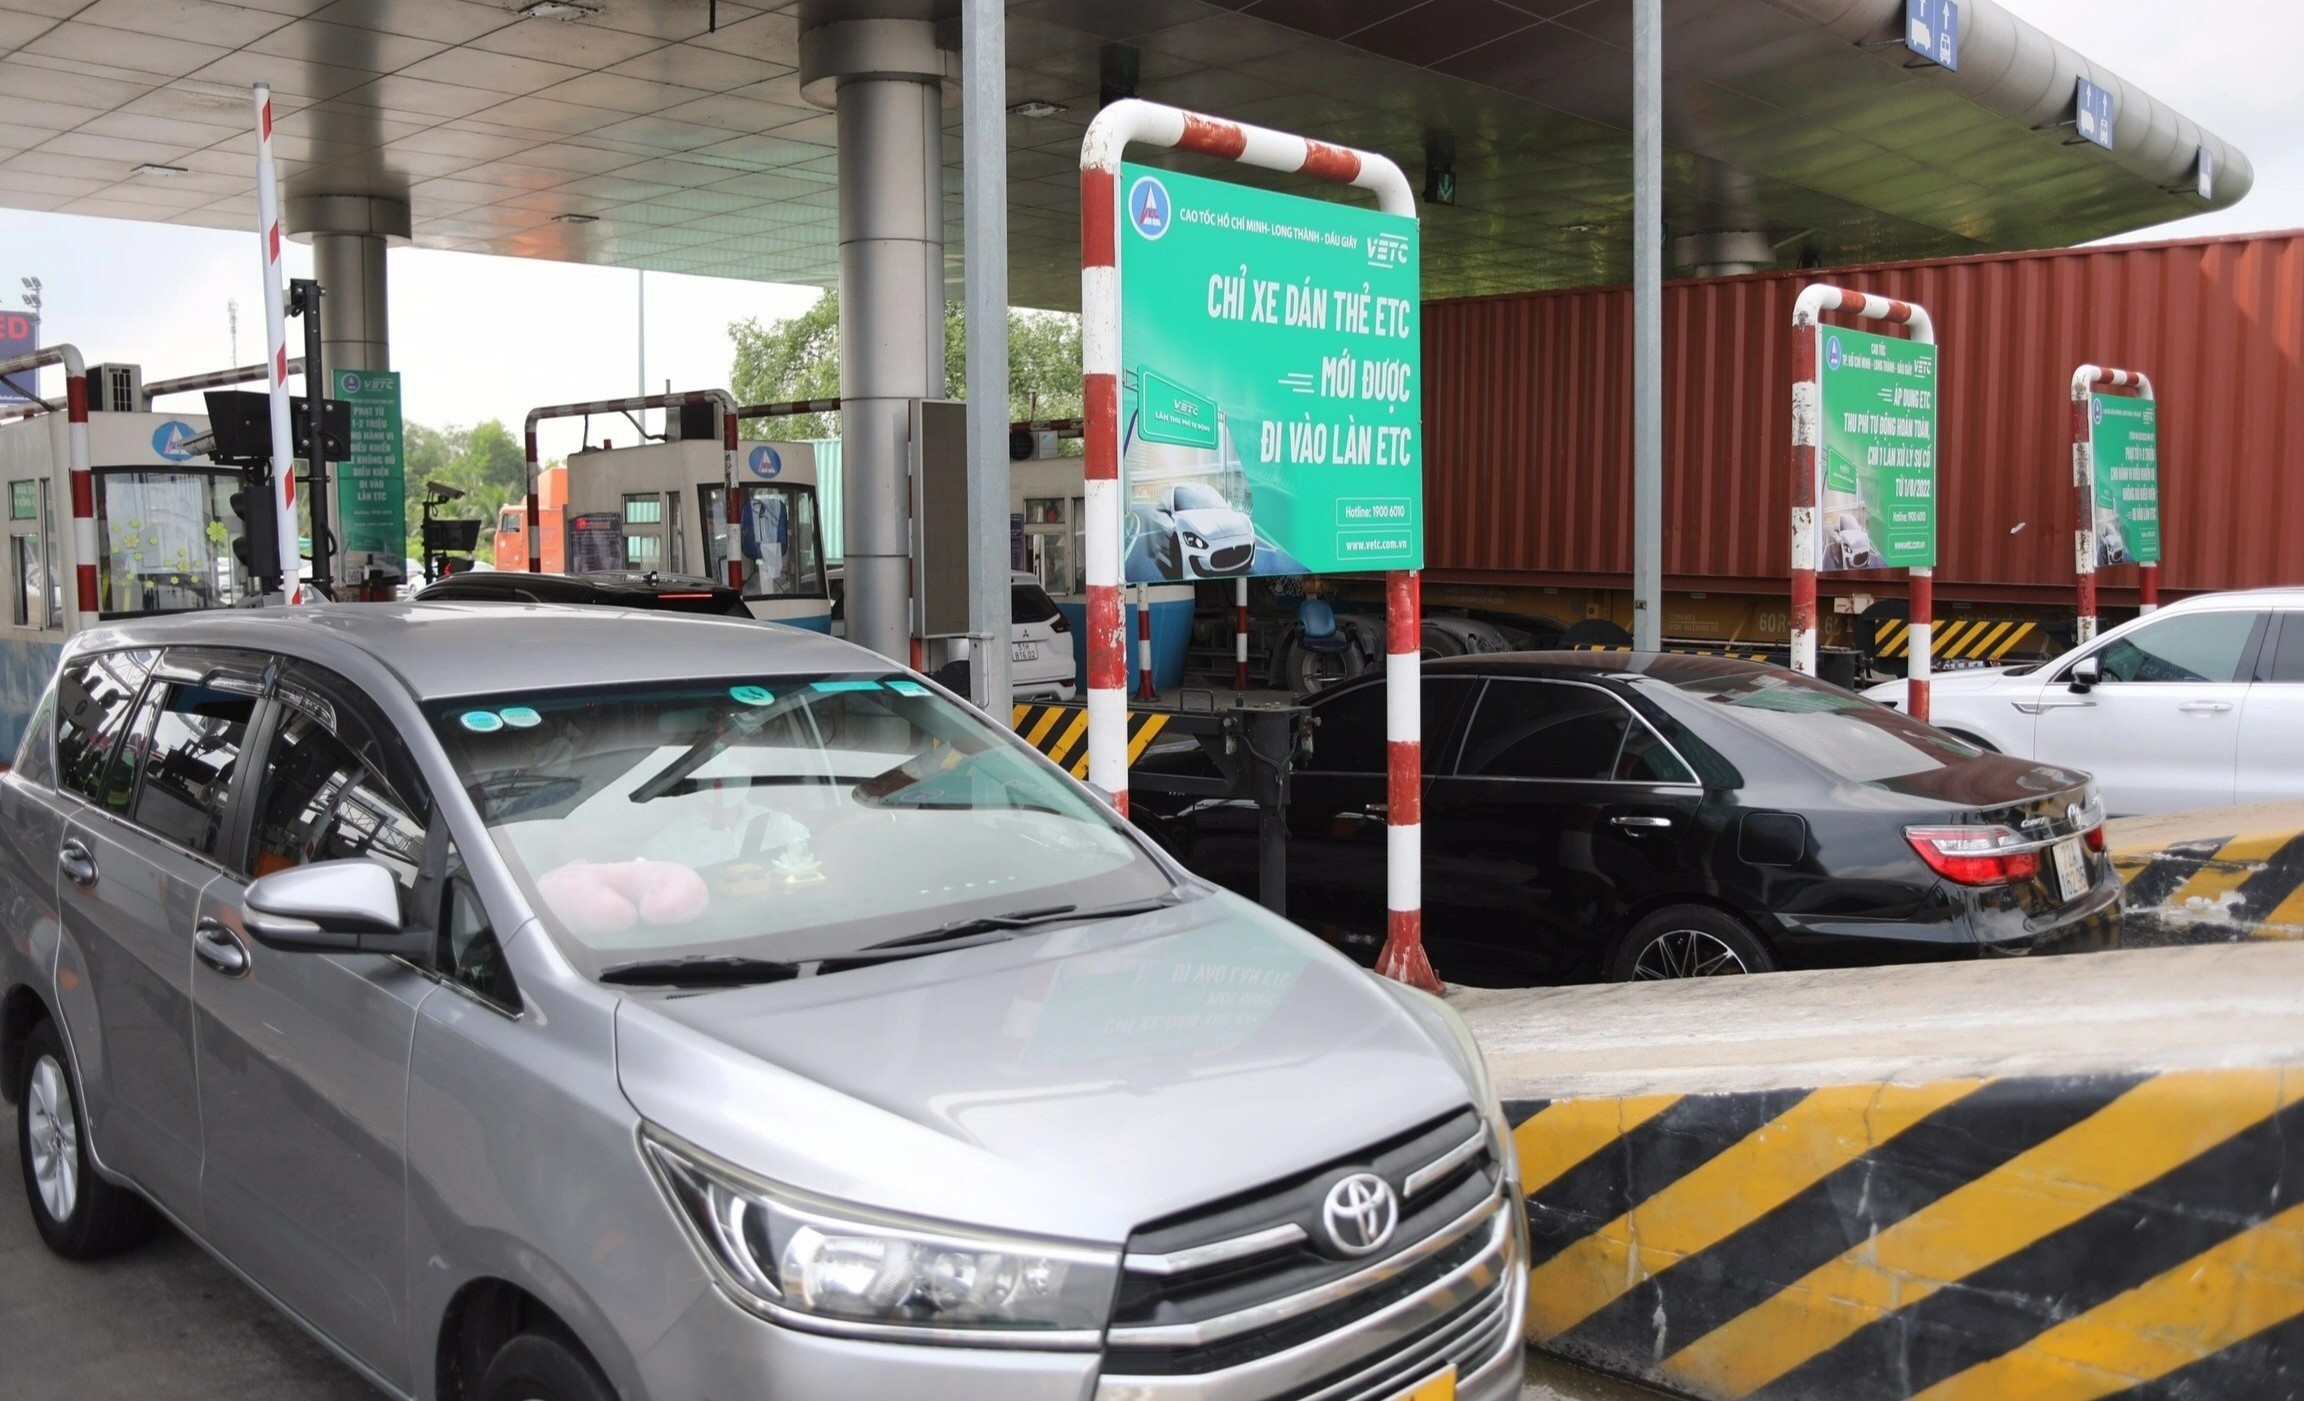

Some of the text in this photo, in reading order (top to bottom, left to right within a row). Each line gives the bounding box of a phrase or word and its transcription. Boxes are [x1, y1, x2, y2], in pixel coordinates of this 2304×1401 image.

[1180, 208, 1198, 222] CAO
[1199, 209, 1216, 226] TỐC
[1231, 216, 1245, 230] CHÍ
[1271, 223, 1293, 238] LONG
[1294, 227, 1320, 243] THÀNH
[1366, 237, 1409, 264] VETC
[1207, 263, 1411, 339] CHỈ XE DÁN THẺ ETC
[1320, 348, 1411, 414] MỚI ĐƯỢC
[1173, 399, 1199, 416] VETC
[1894, 383, 1902, 406] ÁP
[1919, 390, 1931, 409] ETC
[1843, 412, 1857, 433] THU
[1857, 410, 1870, 434] PHÍ
[1260, 411, 1412, 466] ĐI VÀO LÀN ETC
[373, 492, 387, 501] ETC
[1345, 505, 1405, 518] Hotline: 1900 6010
[1345, 539, 1408, 551] www.vetc.com.vn
